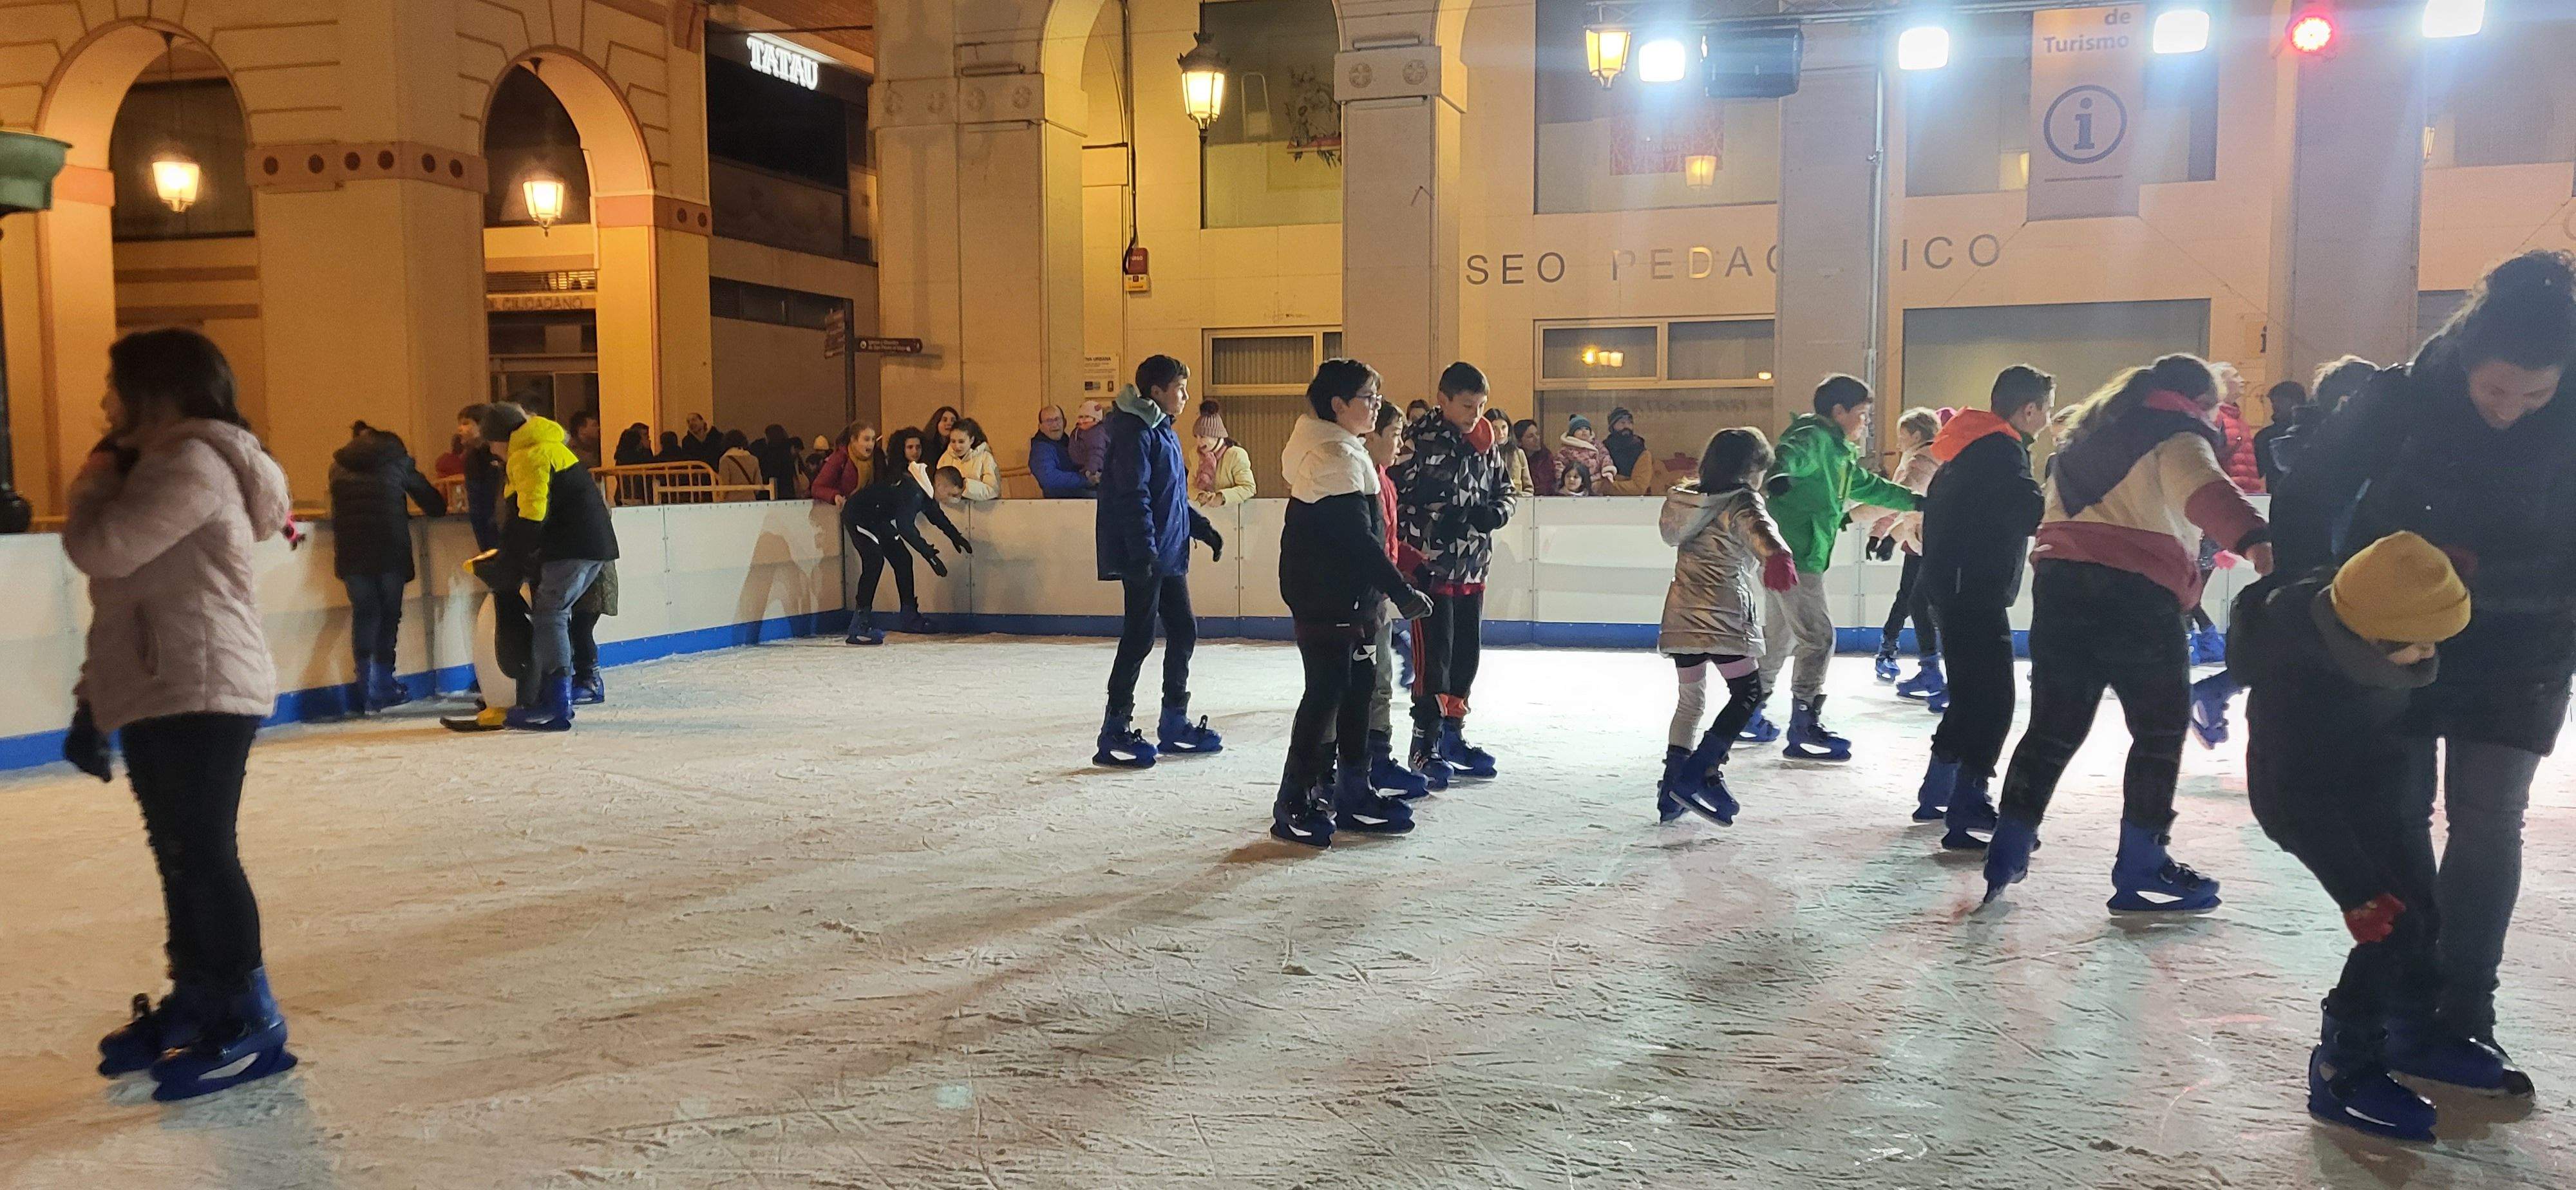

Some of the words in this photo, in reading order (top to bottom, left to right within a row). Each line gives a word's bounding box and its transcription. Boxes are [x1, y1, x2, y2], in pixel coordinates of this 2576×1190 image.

[2104, 8, 2131, 25] de
[2043, 34, 2130, 53] Turismo
[746, 36, 819, 91] TATAU
